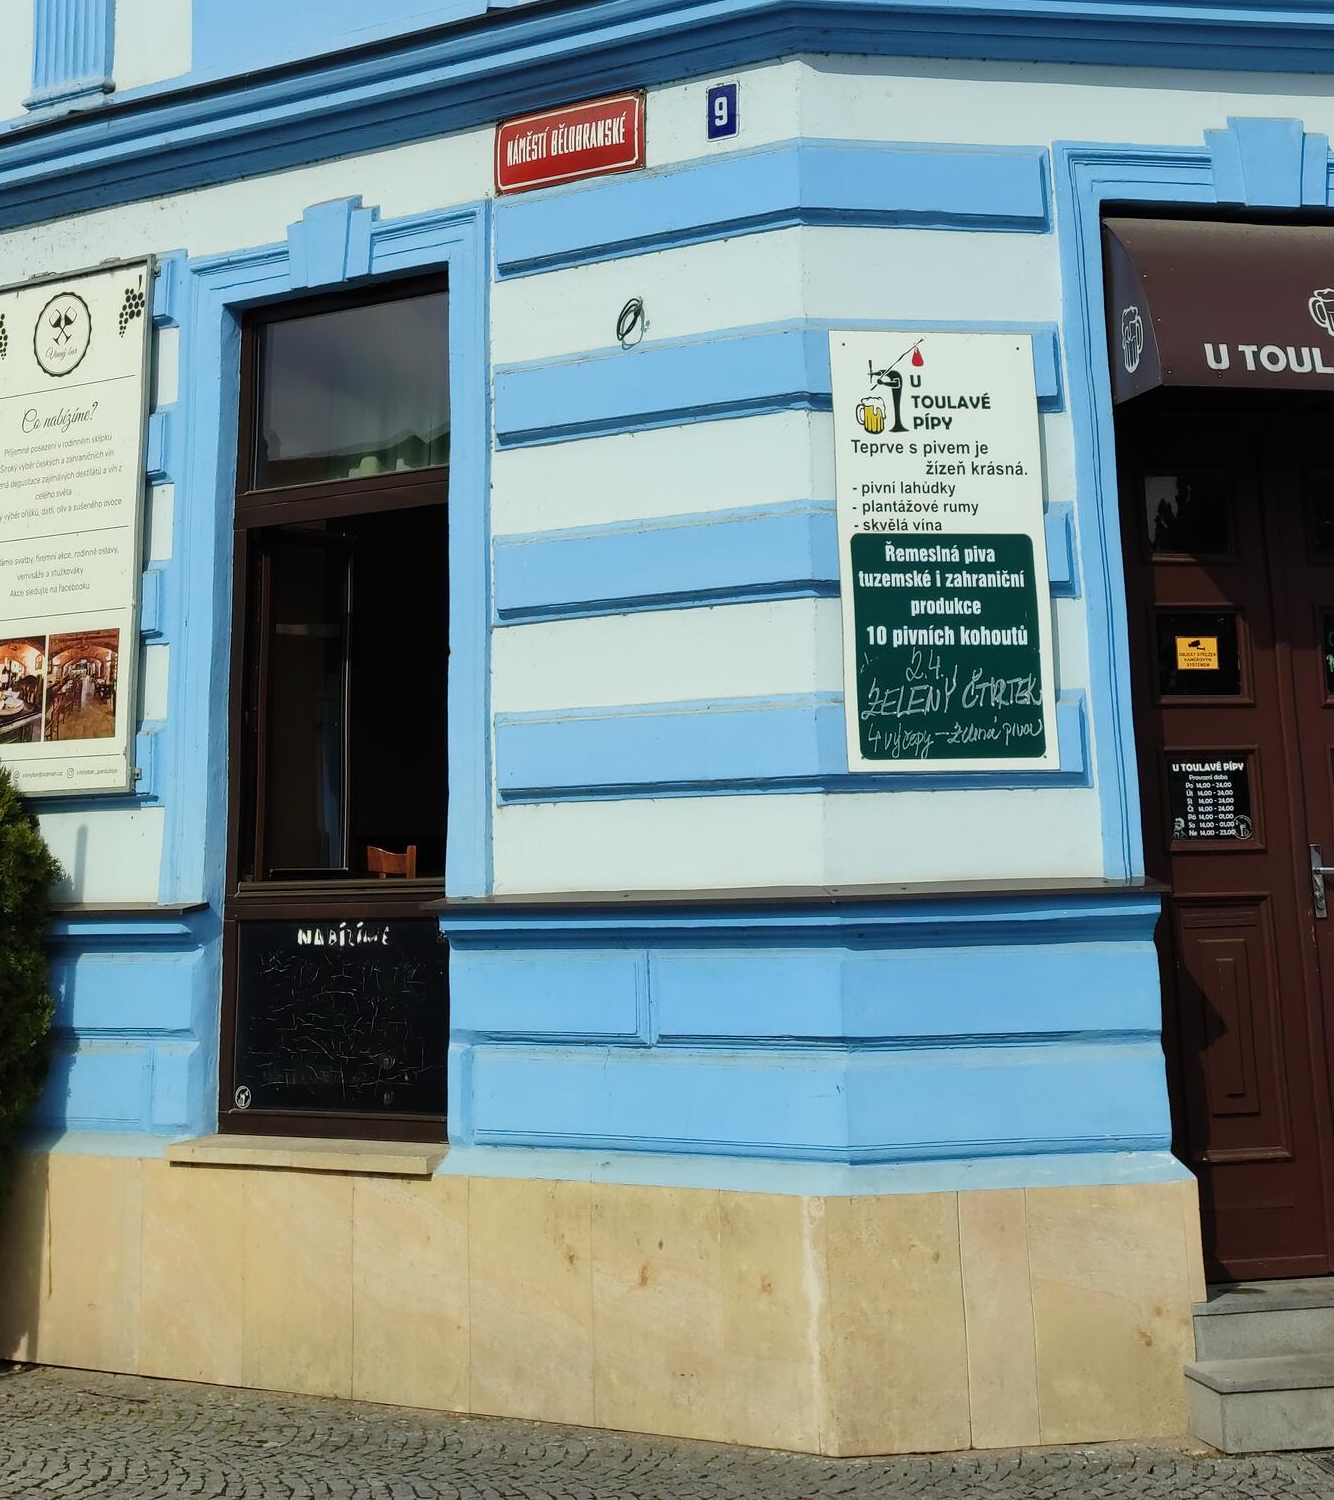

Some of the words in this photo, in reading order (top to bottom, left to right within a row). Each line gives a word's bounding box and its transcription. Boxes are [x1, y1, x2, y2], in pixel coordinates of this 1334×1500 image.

[714, 97, 728, 126] 9
[507, 126, 549, 166] NÁMĚSTÍ
[551, 111, 627, 156] BĚLOBRANSKÉ
[1204, 343, 1229, 370] U
[910, 375, 921, 387] U
[911, 393, 991, 409] TOULAVÉ
[22, 409, 40, 433] Co
[44, 402, 98, 432] nabízíme?
[914, 413, 952, 430] PÍPY
[851, 440, 903, 457] Teprve
[910, 444, 917, 453] s
[924, 441, 970, 457] pivem
[975, 441, 988, 458] je
[926, 461, 965, 475] žízeň
[972, 461, 1027, 475] krásná.
[862, 482, 895, 497] pivní
[901, 481, 955, 497] lahůdky
[863, 501, 938, 515] plantážové
[943, 504, 978, 515] rumy
[863, 519, 908, 531] skvělá
[913, 519, 942, 531] vína
[885, 541, 959, 562] Řemeslná
[965, 546, 995, 564] piva
[859, 570, 931, 587] tuzemské
[936, 571, 941, 587] i
[946, 570, 1024, 587] zahraniční
[911, 597, 981, 616] produkce
[867, 626, 887, 645] 10
[893, 625, 955, 648] pivních
[960, 625, 1028, 645] kohoutů
[1181, 761, 1221, 771] TOULAVÉ
[1223, 761, 1244, 771] PÍPY
